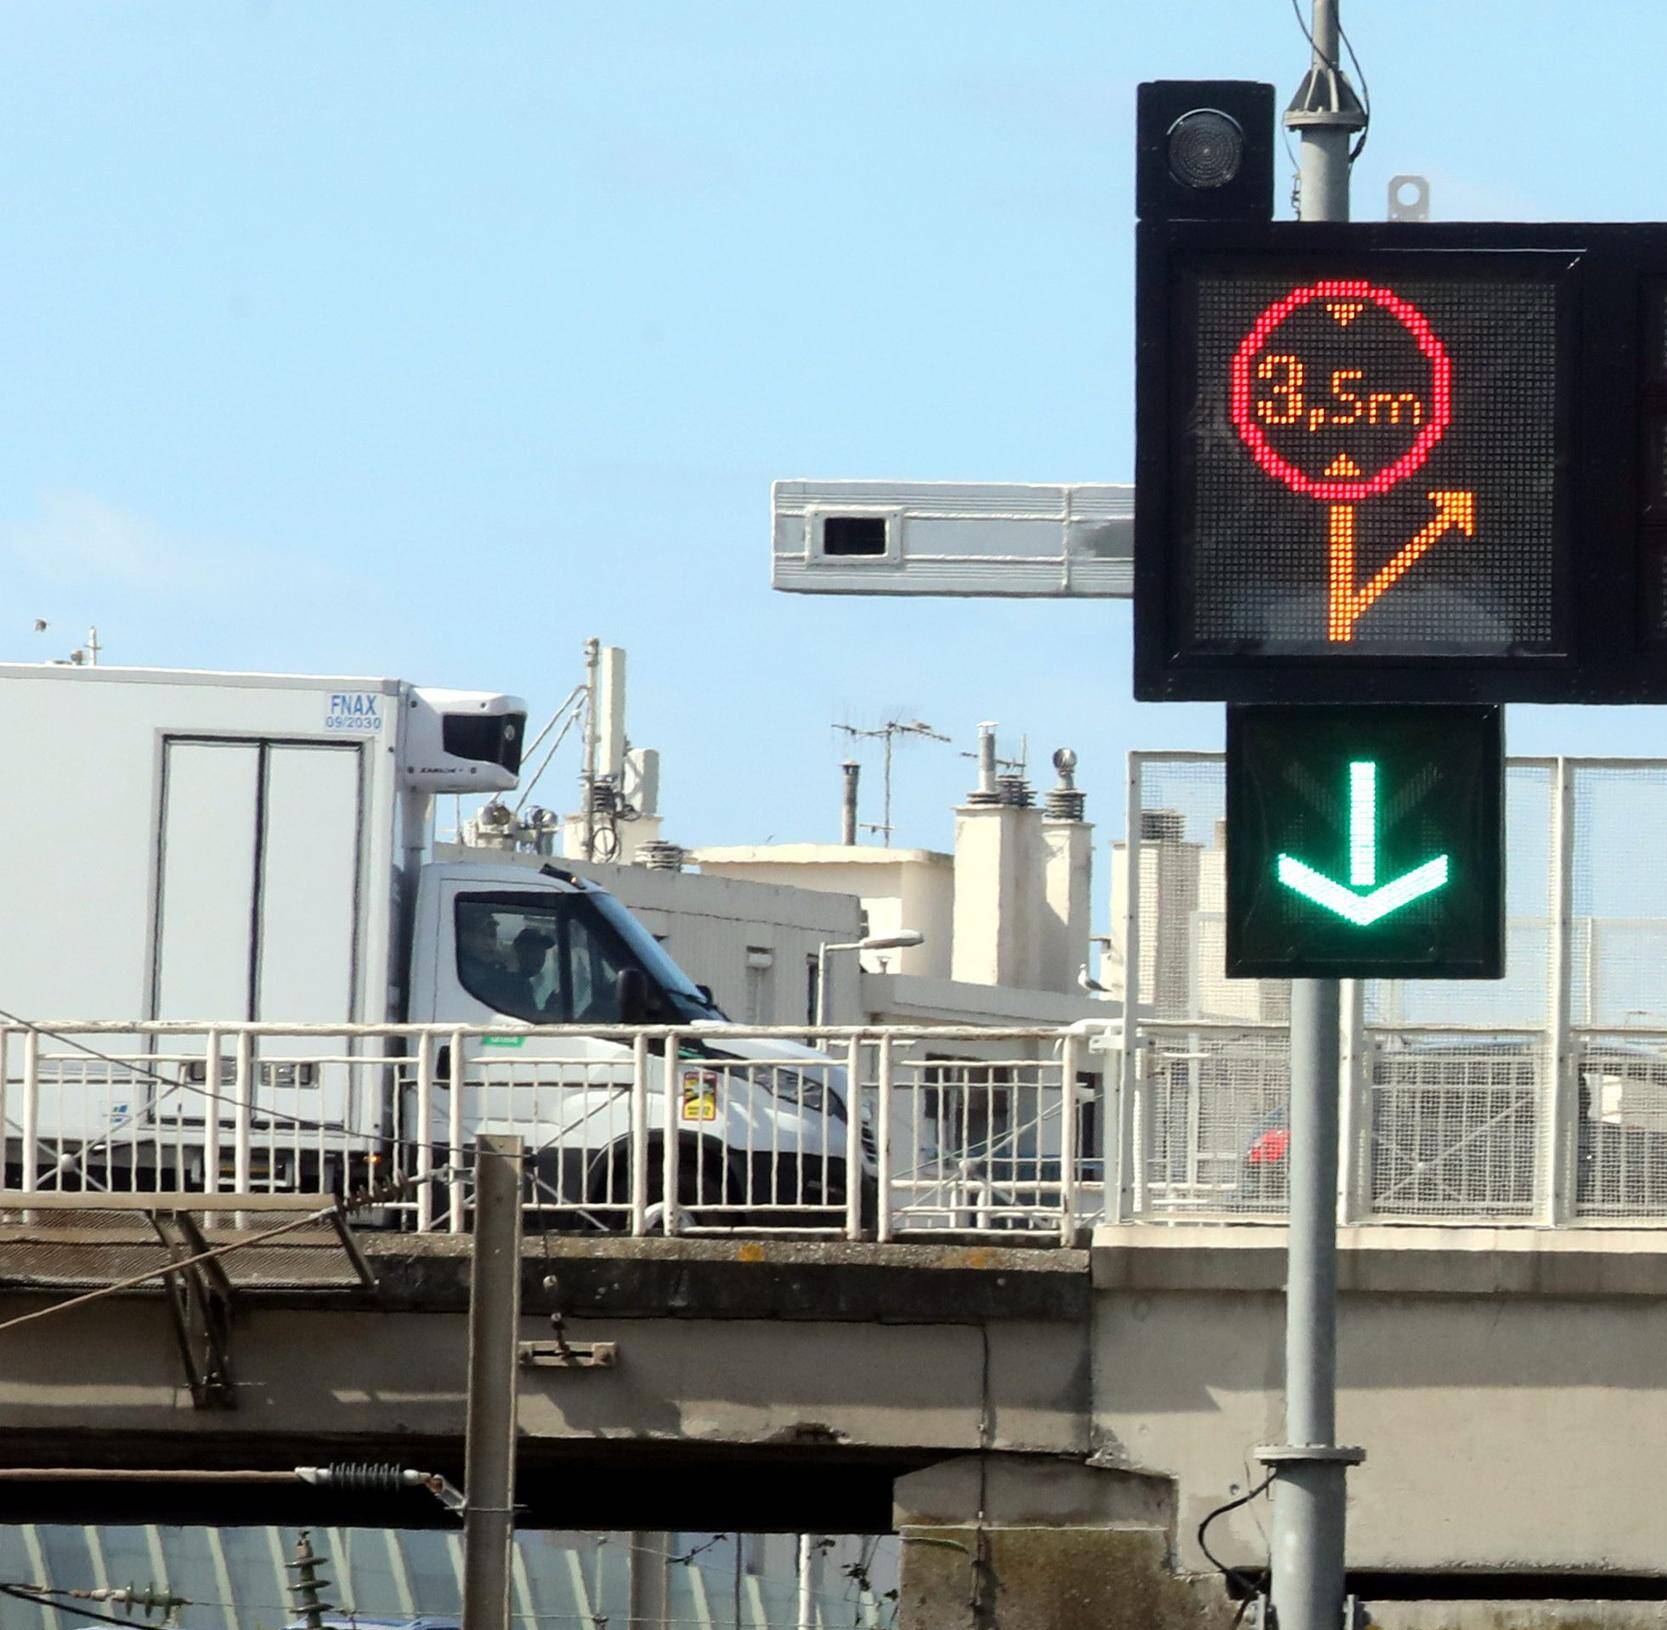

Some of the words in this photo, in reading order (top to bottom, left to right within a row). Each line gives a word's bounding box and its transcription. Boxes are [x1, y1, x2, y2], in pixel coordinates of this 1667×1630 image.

[1257, 355, 1422, 431] 3,5m
[330, 694, 378, 715] FNAX
[326, 716, 382, 730] 09/2030
